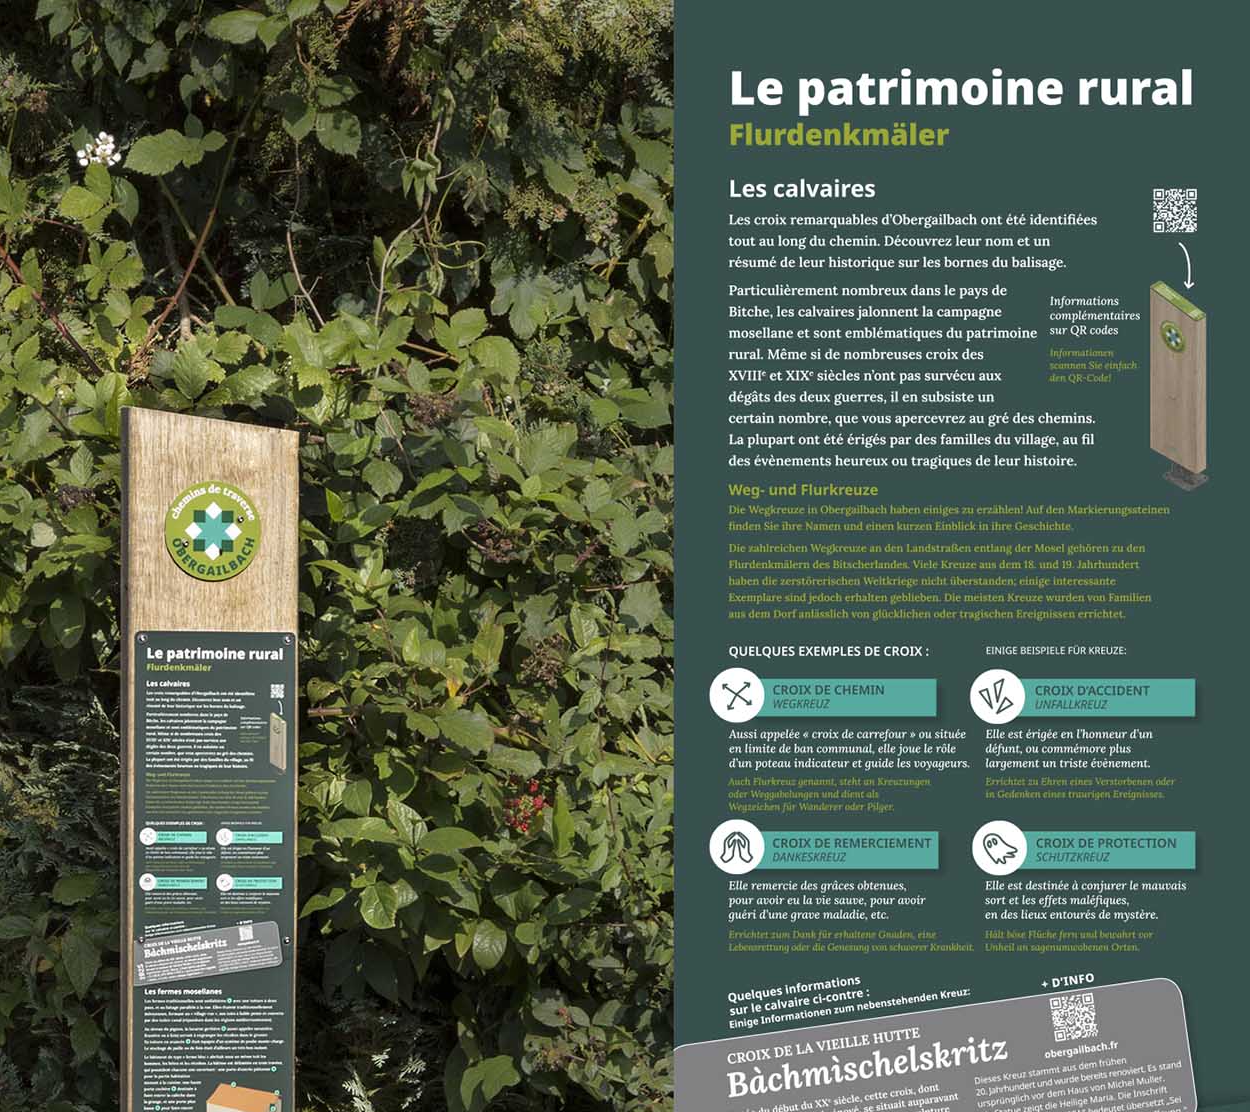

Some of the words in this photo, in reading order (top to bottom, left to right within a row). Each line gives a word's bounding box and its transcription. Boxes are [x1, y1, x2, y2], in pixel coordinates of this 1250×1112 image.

[732, 71, 783, 106] Le
[799, 68, 1063, 116] patrimoine
[1079, 69, 1192, 106] rural
[730, 122, 950, 147] Flurdenkmäler
[730, 180, 767, 198] Les
[774, 178, 875, 198] calvaires
[729, 214, 751, 225] Les
[754, 214, 787, 225] croix
[790, 214, 878, 228] remarquables
[881, 214, 977, 229] d’Obergailbach
[981, 216, 1003, 225] ont
[1005, 214, 1026, 225] été
[1030, 213, 1097, 225] identifiées
[1050, 296, 1119, 308] Informations
[1050, 310, 1141, 322] complémentaires
[1070, 324, 1087, 337] QR
[1089, 325, 1119, 336] codes
[208, 484, 221, 494] de
[727, 484, 765, 499] Weg-
[769, 483, 796, 496] und
[801, 483, 878, 496] Flurkreuze
[172, 538, 255, 576] OBERGAILBACH
[147, 647, 163, 660] Le
[167, 647, 245, 662] patrimoine
[249, 647, 283, 660] rural
[729, 646, 795, 659] QUELQUES
[799, 646, 861, 656] EXEMPLES
[864, 646, 880, 656] DE
[884, 646, 922, 656] CROIX
[986, 646, 1017, 655] EINIGE
[1020, 646, 1065, 655] BEISPIELE
[1068, 645, 1087, 655] FÜR
[1088, 646, 1127, 655] KREUZE:
[146, 680, 158, 688] Les
[159, 680, 191, 688] calvaires
[773, 685, 812, 697] CROIX
[815, 684, 831, 696] DE
[834, 684, 886, 696] CHEMIN
[1034, 684, 1074, 697] CROIX
[1077, 684, 1150, 696] D’ACCIDENT
[773, 698, 831, 710] WEGKREUZ
[1034, 698, 1110, 711] UNFALLKREUZ
[729, 729, 757, 739] Aussi
[760, 729, 800, 741] appelée
[812, 729, 839, 739] croix
[841, 729, 854, 739] de
[856, 729, 907, 741] carrefour
[918, 731, 932, 739] ou
[934, 729, 966, 739] située
[773, 837, 812, 849] CROIX
[814, 838, 831, 849] DE
[833, 836, 932, 849] REMERCIEMENT
[1036, 838, 1075, 849] CROIX
[1078, 838, 1094, 849] DE
[1098, 838, 1176, 849] PROTECTION
[771, 851, 847, 863] DANKESKREUZ
[1032, 851, 1111, 863] SCHUTZKREUZ
[729, 880, 749, 890] Elle
[751, 880, 798, 890] remercie
[800, 880, 818, 890] des
[820, 880, 855, 893] grâces
[857, 880, 906, 891] obtenues,
[1052, 973, 1094, 987] D'INFO
[144, 988, 157, 996] Les
[158, 988, 182, 996] fermes
[183, 988, 223, 996] mosellanes
[728, 988, 783, 1004] Quelques
[785, 977, 861, 994] informations
[729, 1018, 758, 1028] Einige
[761, 1008, 832, 1024] Informationen
[834, 1005, 855, 1014] zum
[857, 993, 938, 1010] nebenstehenden
[940, 989, 970, 999] Kreuz:
[730, 1006, 748, 1016] sur
[751, 1003, 761, 1012] le
[765, 997, 810, 1011] calvaire
[813, 990, 863, 1004] ci-contre
[727, 1048, 771, 1064] CROIX
[774, 1045, 793, 1059] DE
[796, 1043, 814, 1054] LA
[816, 1034, 870, 1051] VIEILLE
[873, 1027, 920, 1044] HUTTE
[1045, 1041, 1118, 1058] obergailbach.fr
